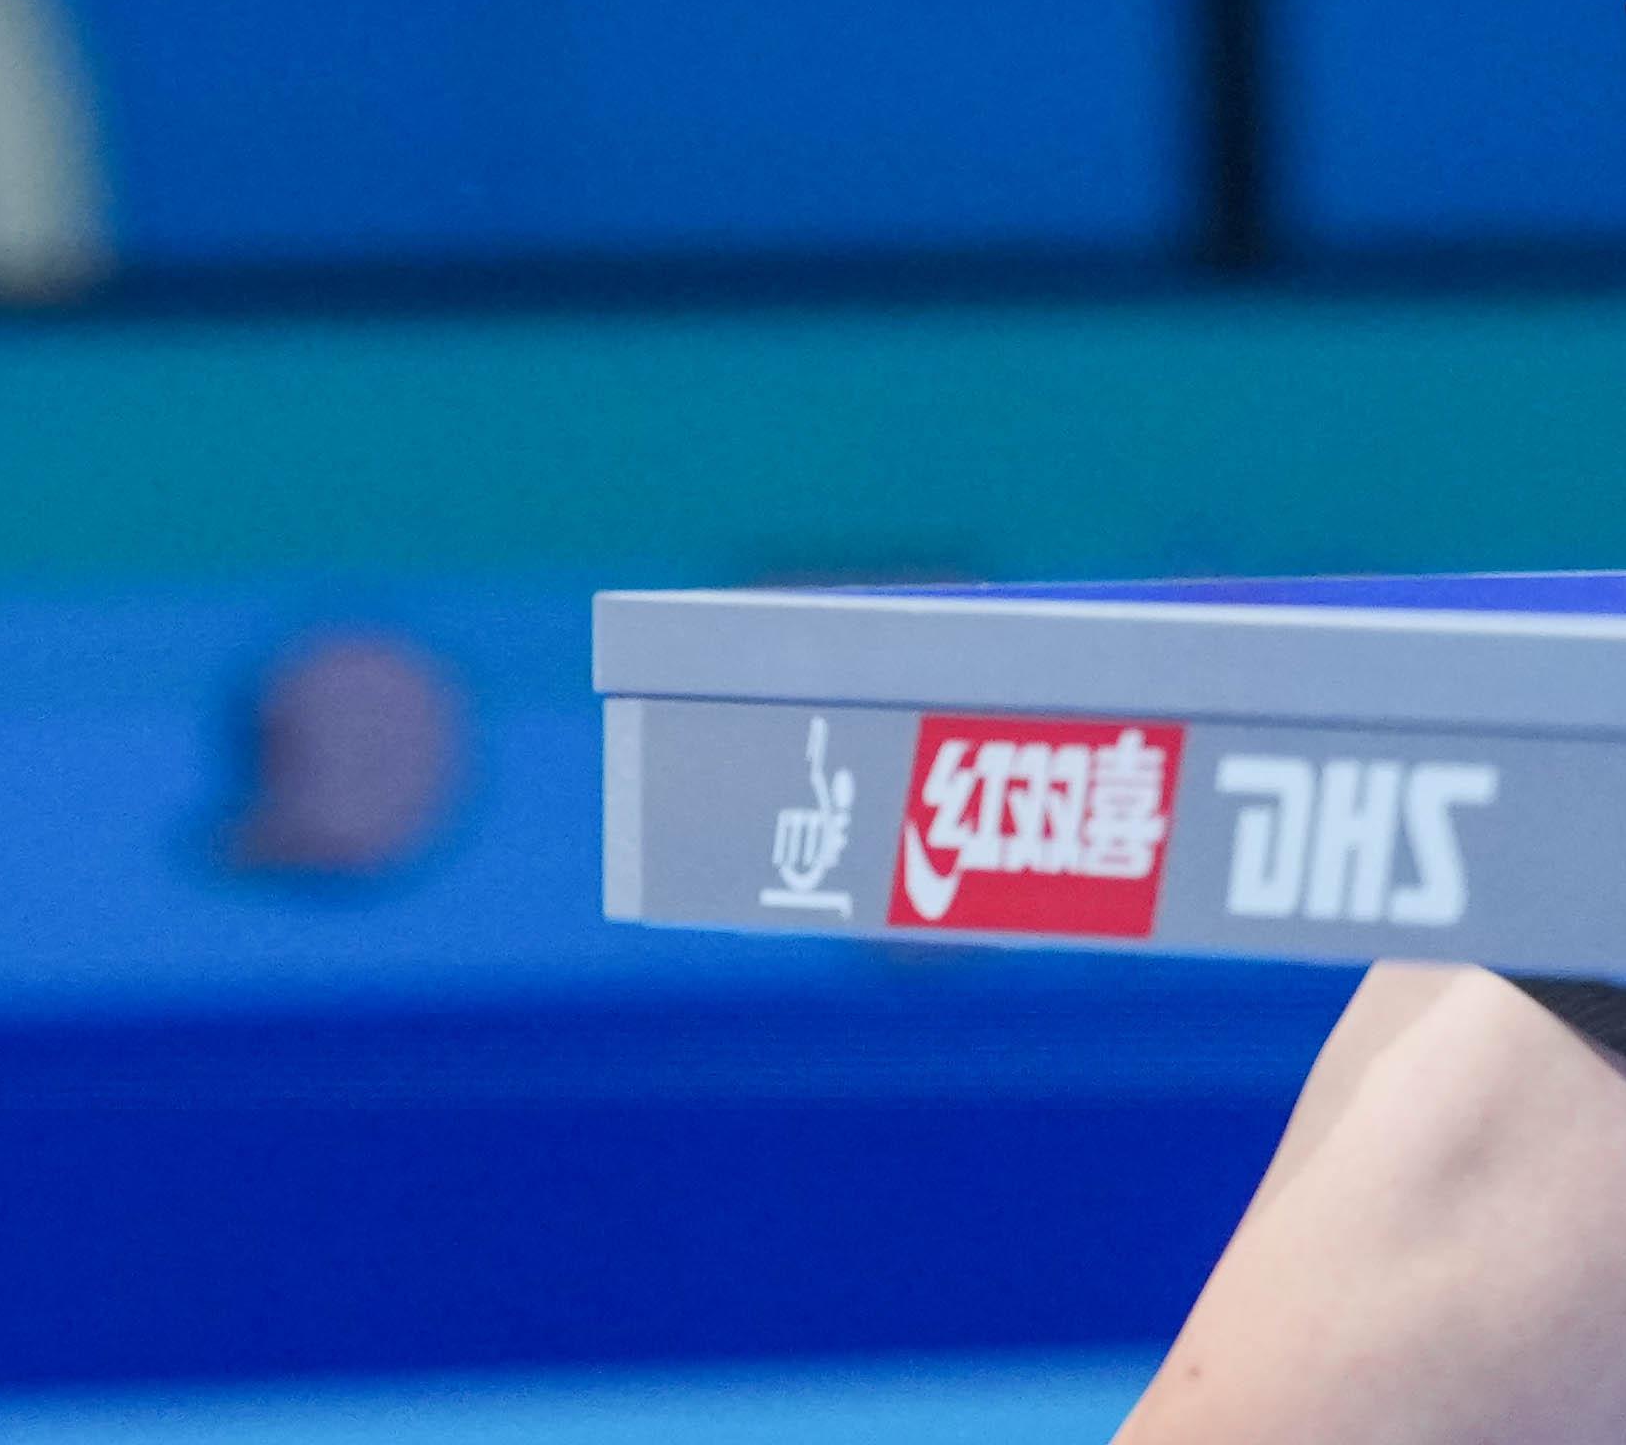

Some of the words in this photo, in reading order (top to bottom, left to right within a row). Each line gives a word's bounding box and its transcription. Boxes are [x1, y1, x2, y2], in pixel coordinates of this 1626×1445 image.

[904, 728, 1170, 920] 红双喜
[1214, 754, 1499, 926] DHS
